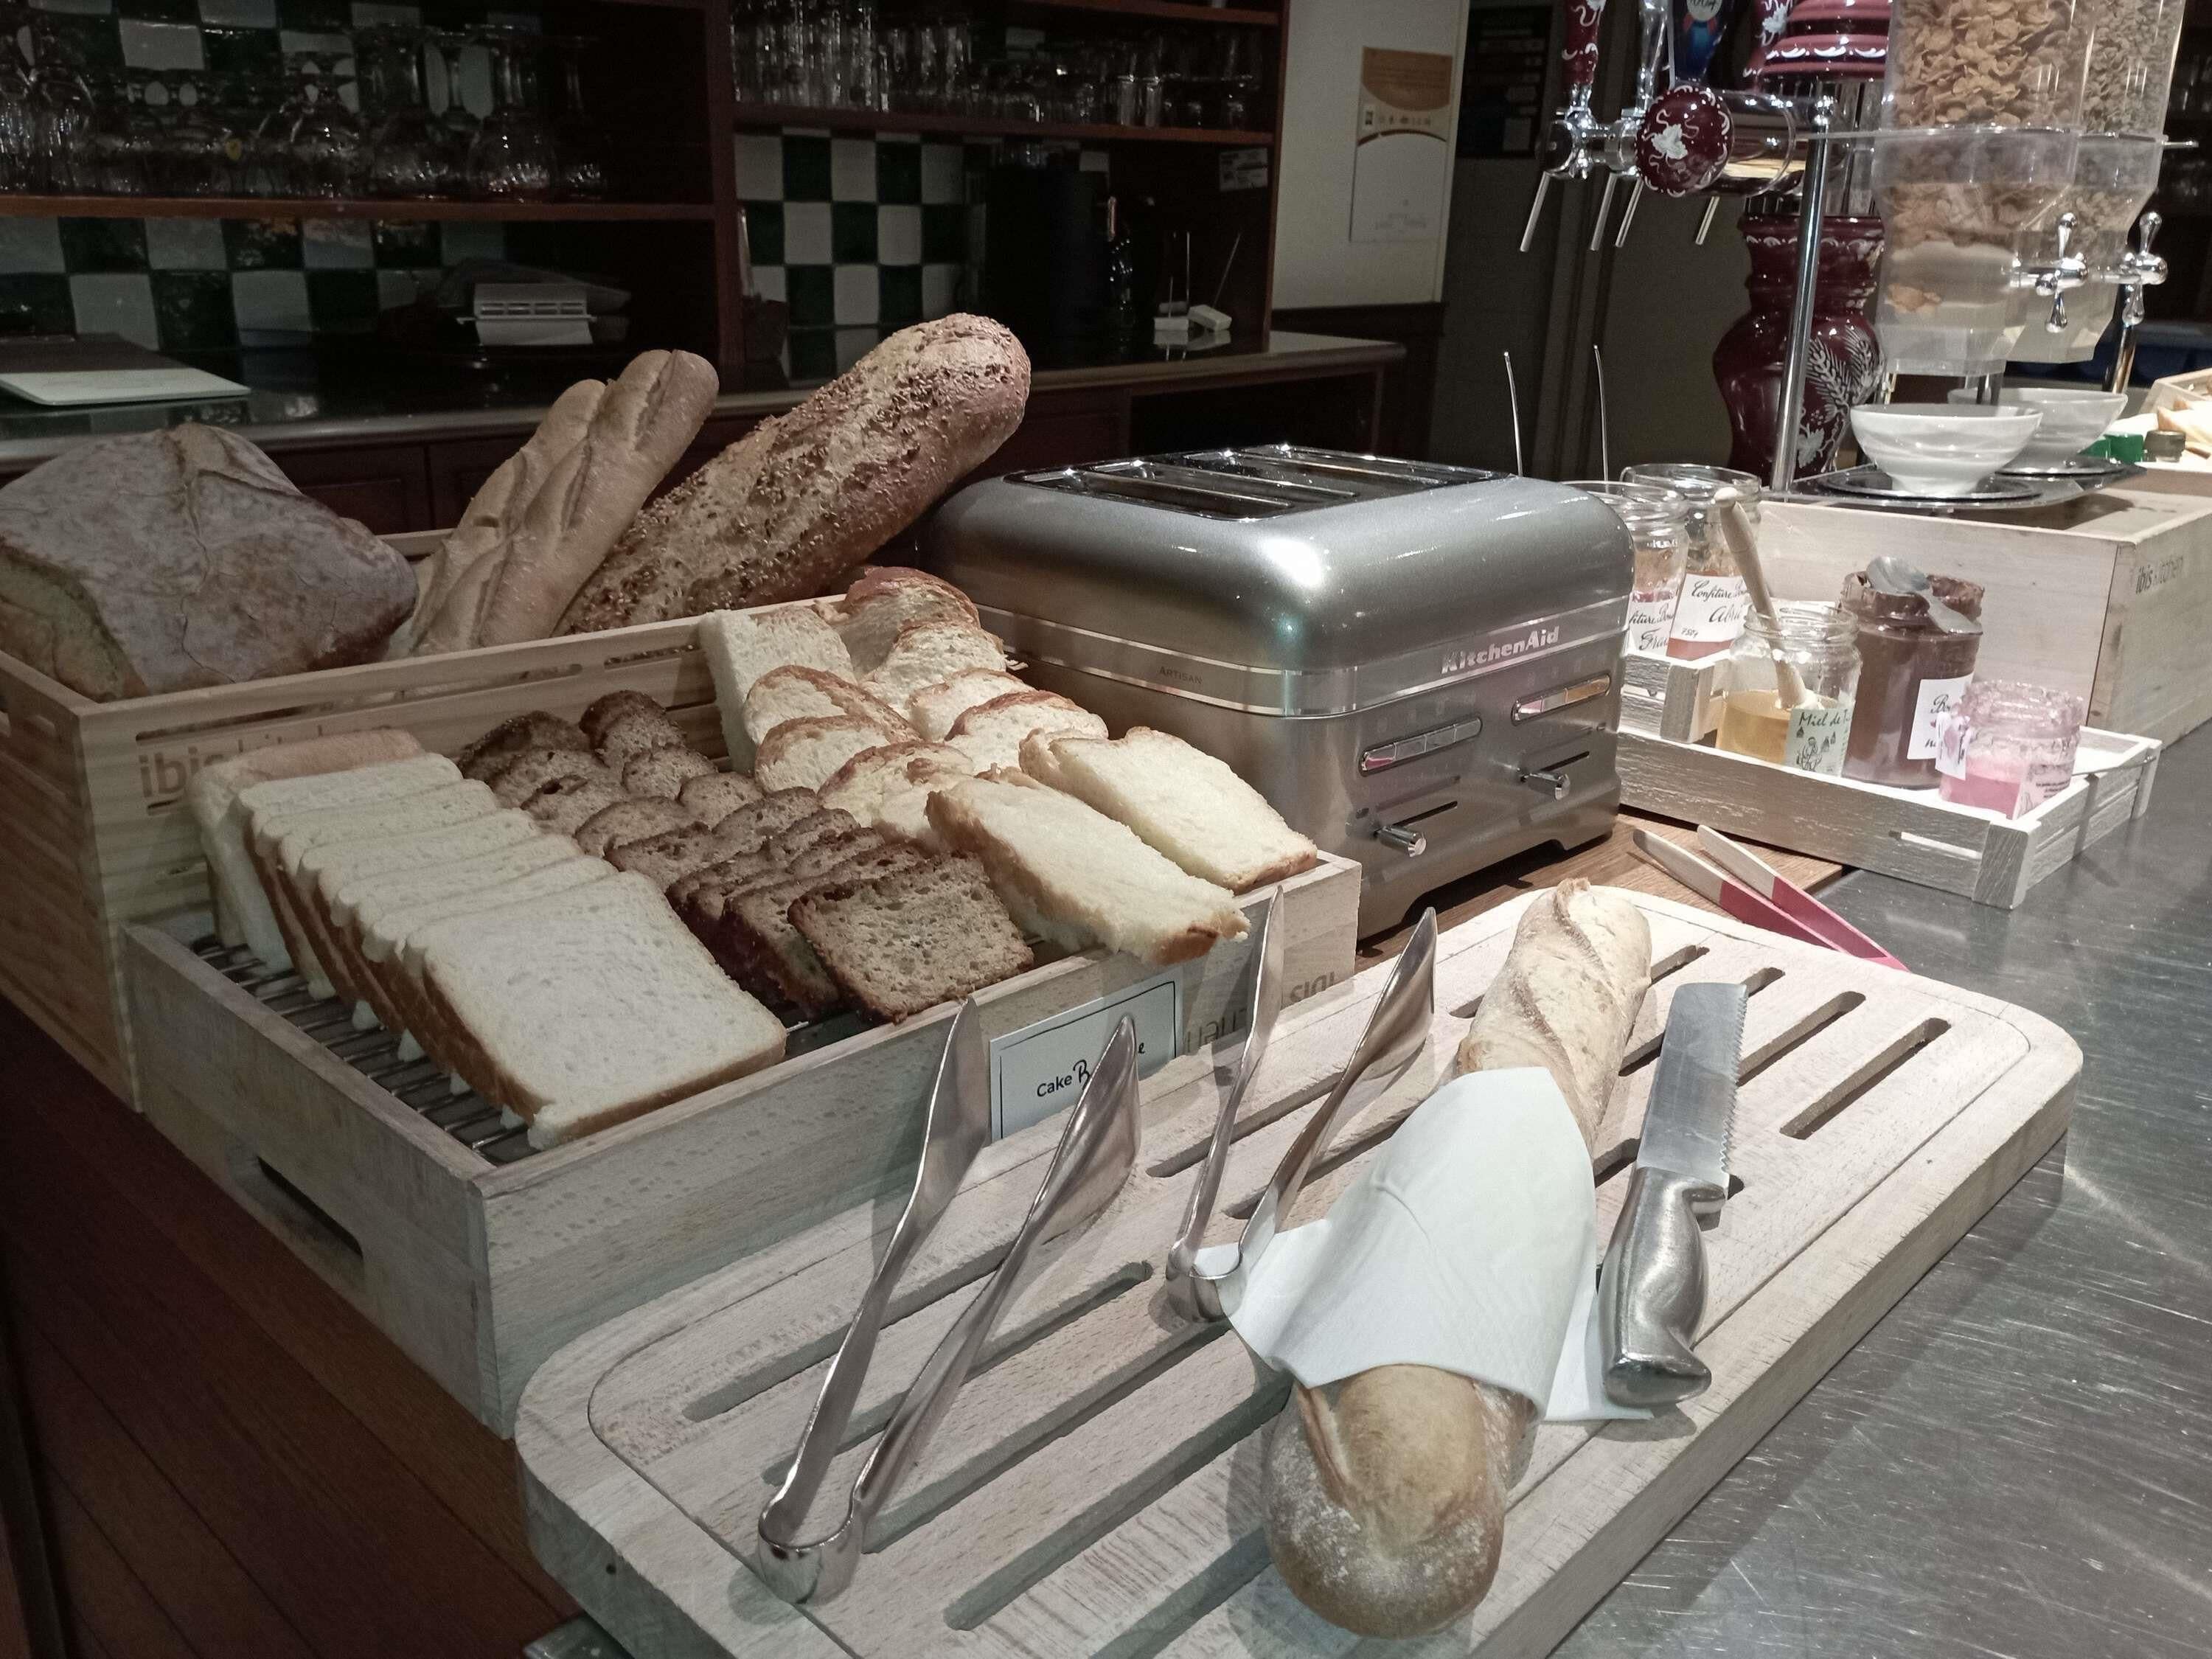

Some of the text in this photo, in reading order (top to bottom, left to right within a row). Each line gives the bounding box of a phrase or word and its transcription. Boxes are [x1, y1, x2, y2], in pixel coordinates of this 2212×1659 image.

[1691, 580, 1733, 602] Confiture
[1441, 626, 1560, 674] KitchenAid
[1159, 666, 1203, 685] ARTISAN
[1799, 712, 1828, 726] Miel
[139, 746, 223, 799] ibi
[1037, 1076, 1072, 1097] Cake
